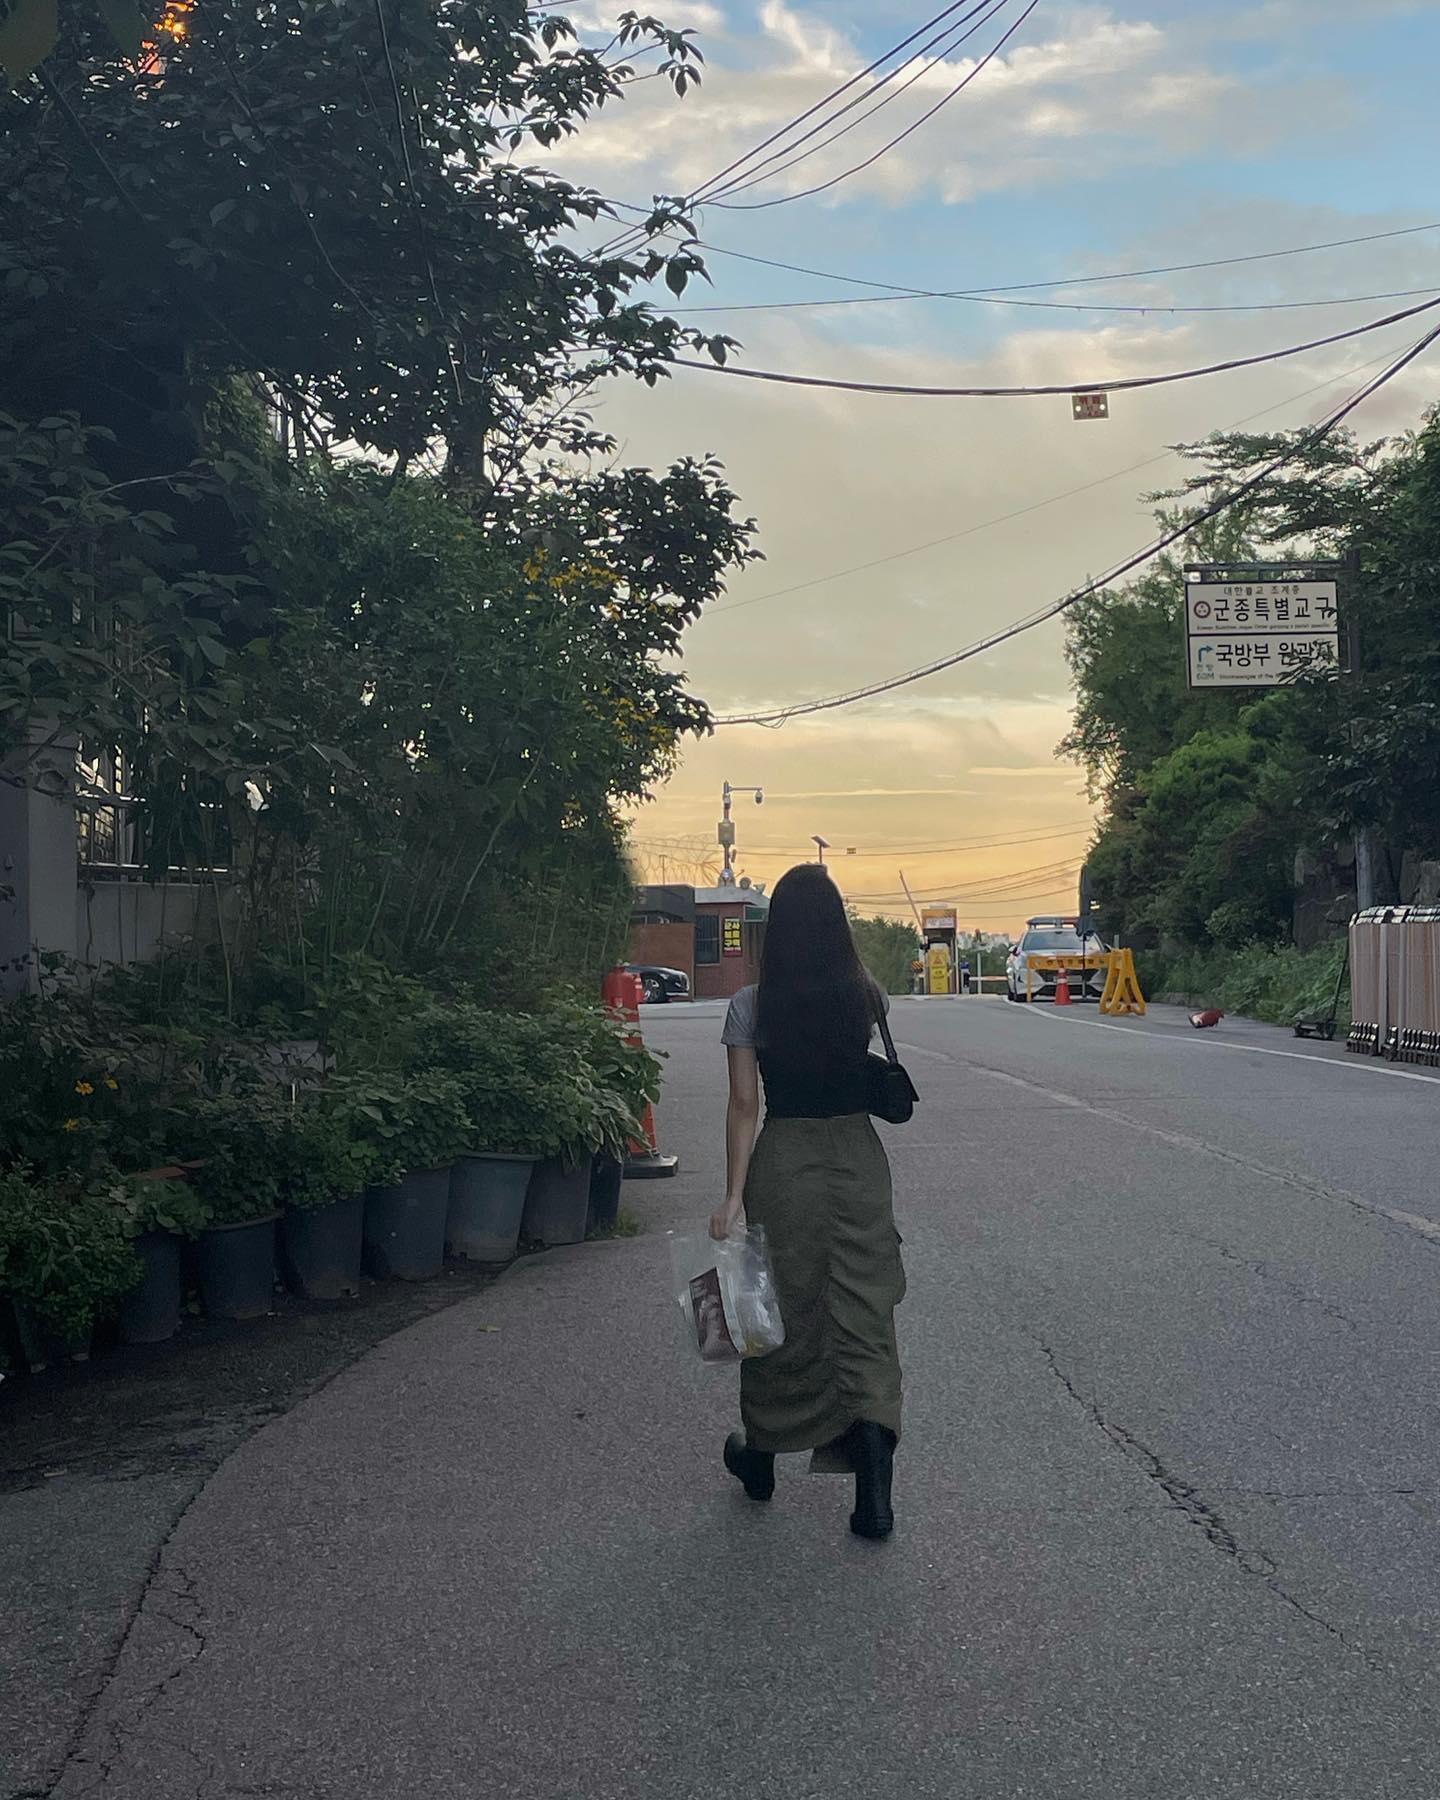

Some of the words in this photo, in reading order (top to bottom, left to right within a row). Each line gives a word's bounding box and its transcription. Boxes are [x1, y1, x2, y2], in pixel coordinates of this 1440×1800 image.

[1270, 585, 1300, 595] 조계종
[1213, 597, 1331, 622] 군종특별교구
[1215, 642, 1271, 667] 국방부
